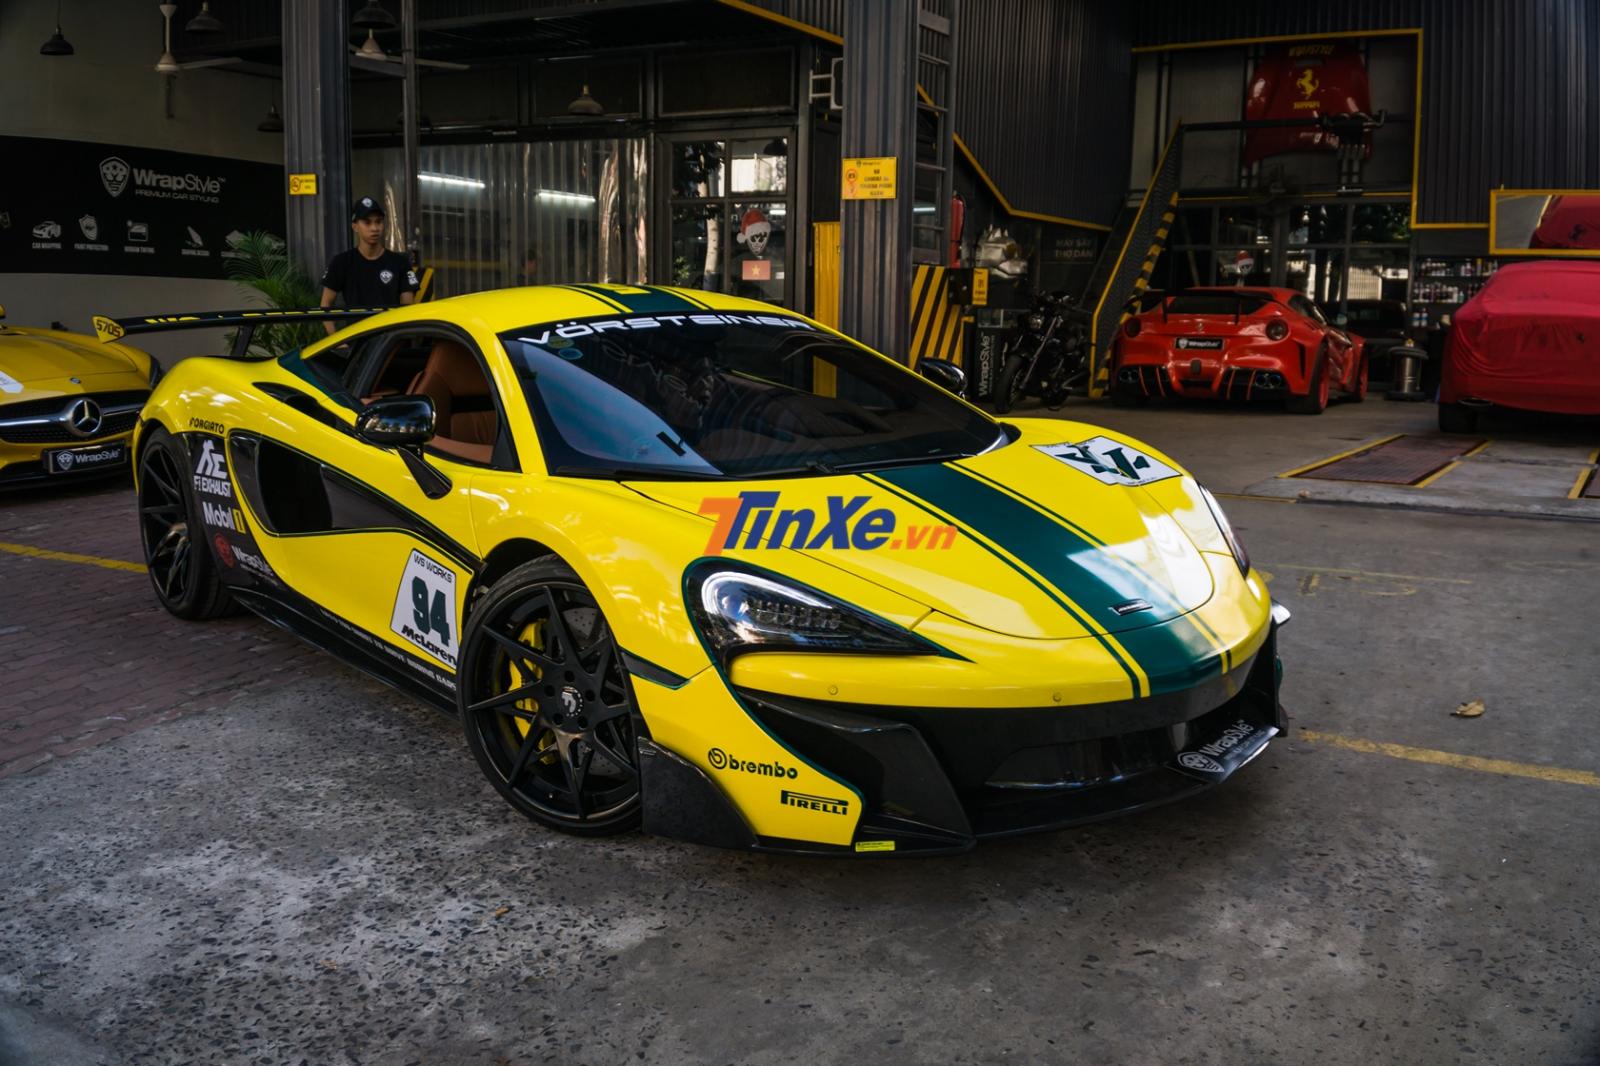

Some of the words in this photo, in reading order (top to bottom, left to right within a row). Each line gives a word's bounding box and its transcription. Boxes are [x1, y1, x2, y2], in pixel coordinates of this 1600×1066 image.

[202, 501, 236, 530] Mobil
[414, 553, 426, 568] WS
[425, 559, 452, 583] WORKS
[412, 576, 450, 647] 94
[401, 624, 457, 665] McLaren
[729, 755, 798, 779] brembo
[780, 790, 849, 816] PIRELLI
